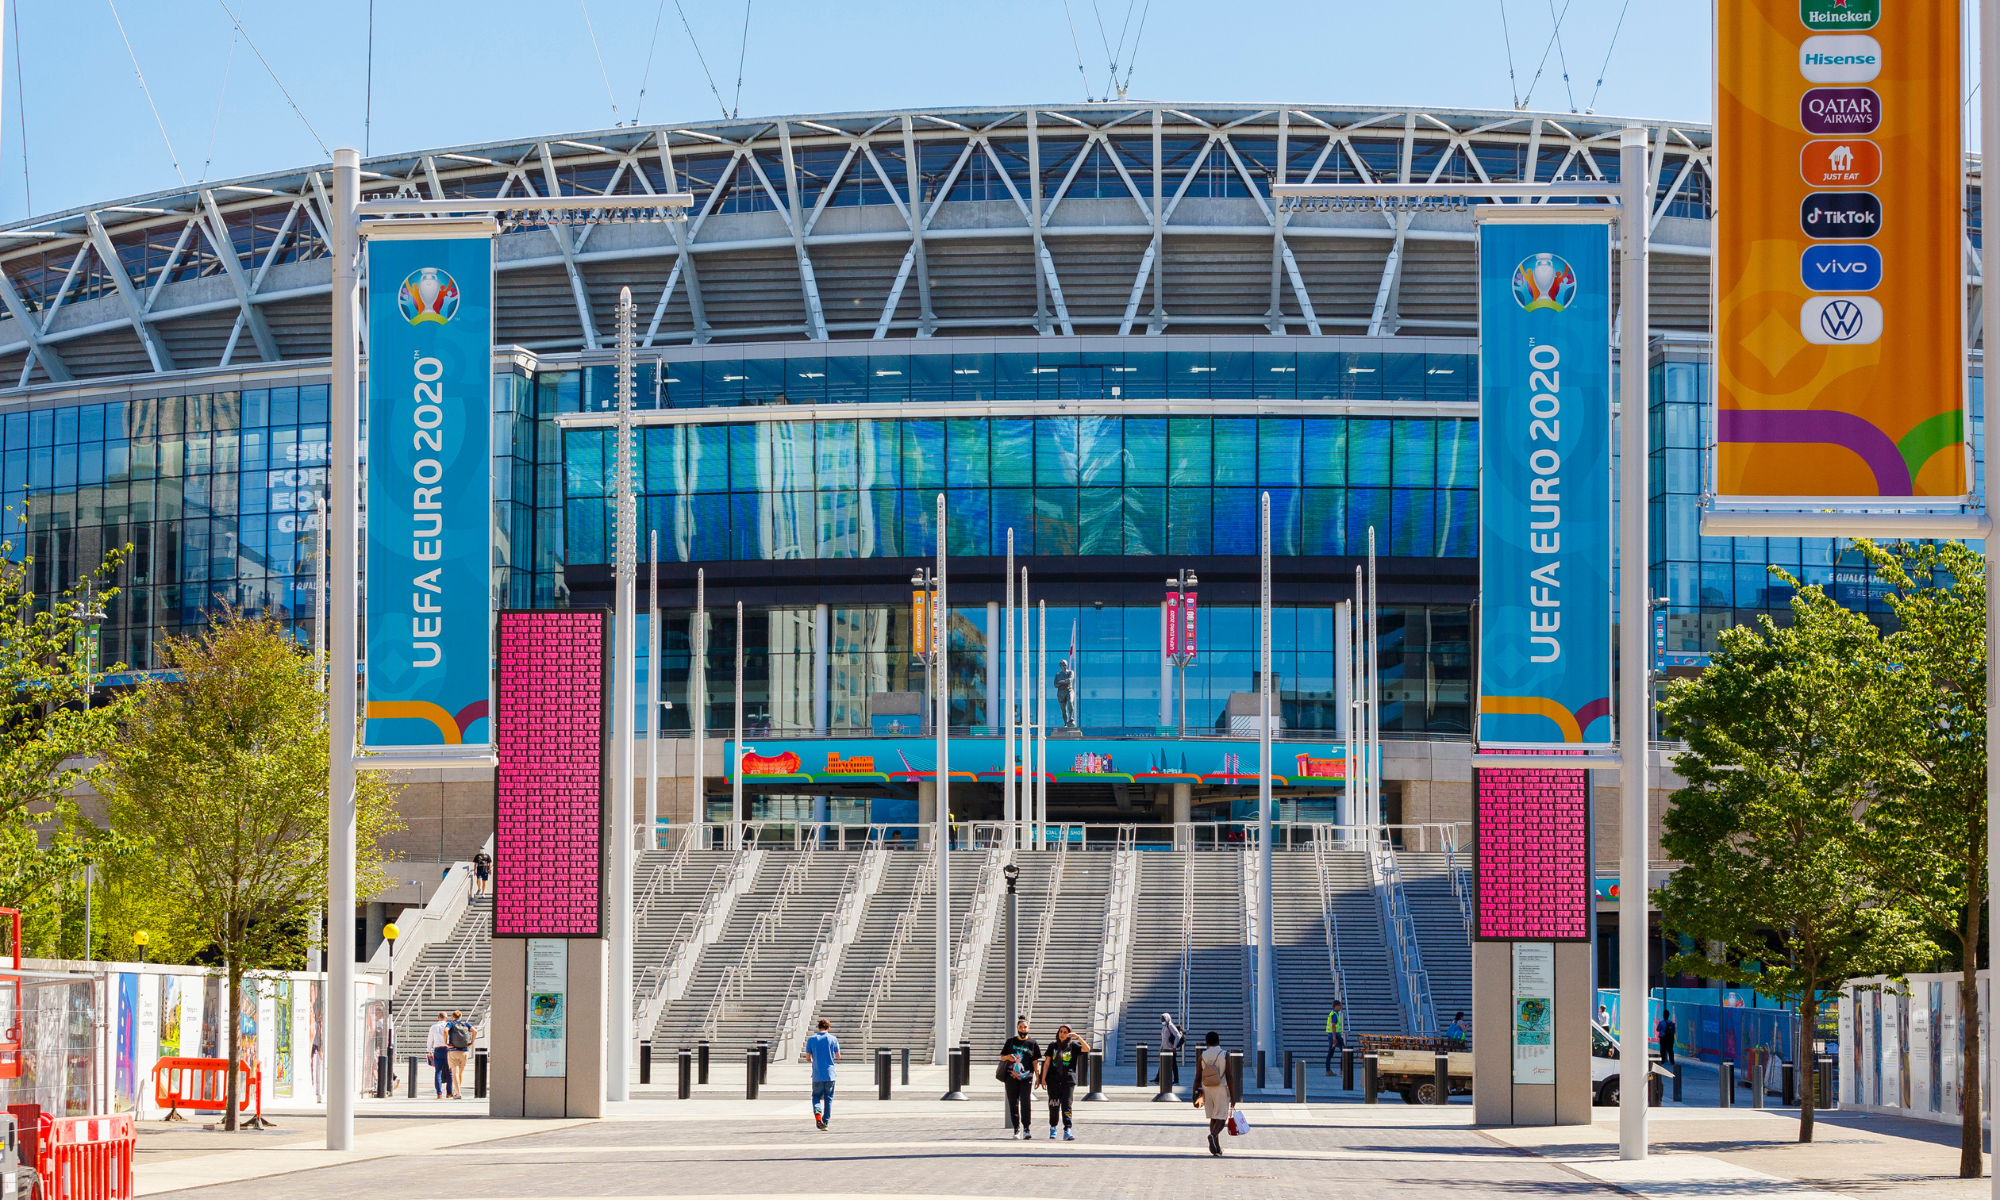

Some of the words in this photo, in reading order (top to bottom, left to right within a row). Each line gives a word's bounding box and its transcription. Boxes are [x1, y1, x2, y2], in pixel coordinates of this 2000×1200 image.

[1809, 10, 1871, 23] Heineken
[1805, 53, 1876, 66] Hisense
[1808, 98, 1872, 115] QATAR
[1824, 114, 1873, 124] AIRWAYS
[1823, 173, 1842, 181] JUST
[1824, 211, 1875, 224] TikTok
[1816, 259, 1867, 273] vivo
[1529, 344, 1560, 442] 2020
[413, 357, 443, 452] 2020
[412, 459, 443, 561] EURO
[1530, 450, 1560, 554] EURO
[412, 567, 442, 668] UEFA
[1530, 562, 1561, 663] UEFA
